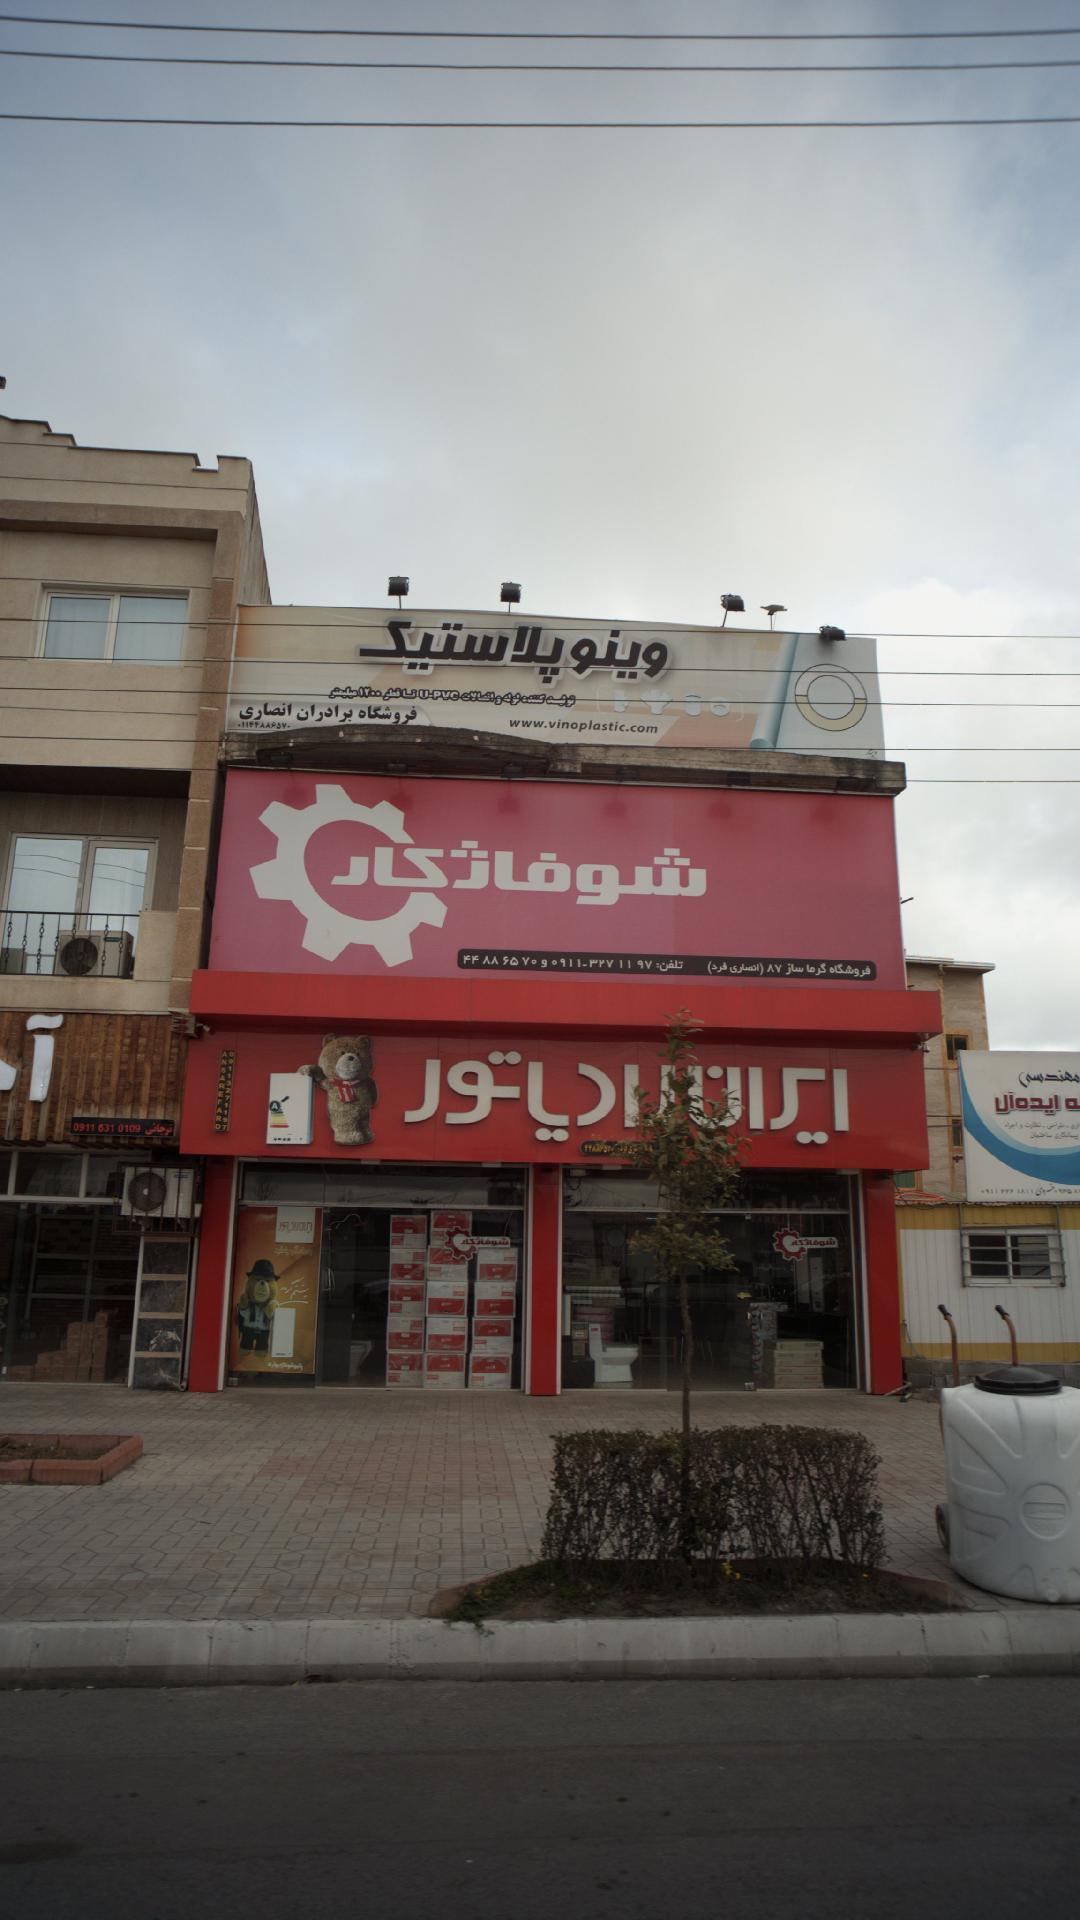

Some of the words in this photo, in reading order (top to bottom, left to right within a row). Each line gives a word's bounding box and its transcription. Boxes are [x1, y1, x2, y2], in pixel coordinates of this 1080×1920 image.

[418, 689, 459, 700] U-PVC
[495, 695, 501, 705] و
[239, 702, 292, 720] انصاری
[297, 704, 353, 722] برادران
[359, 706, 417, 724] فروشگاه
[509, 718, 658, 734] www.vinoplastic.com
[541, 958, 547, 968] و
[619, 959, 631, 969] ۱۱
[637, 960, 652, 970] ۹۷
[656, 959, 683, 972] تلفن:
[708, 960, 728, 975] فرد)
[730, 961, 764, 976] (انصاری
[767, 963, 781, 974] ۸۷
[786, 964, 804, 976] ساز
[806, 964, 826, 976] گرما
[829, 964, 871, 977] فروشگاه
[688, 1065, 849, 1144] ایران
